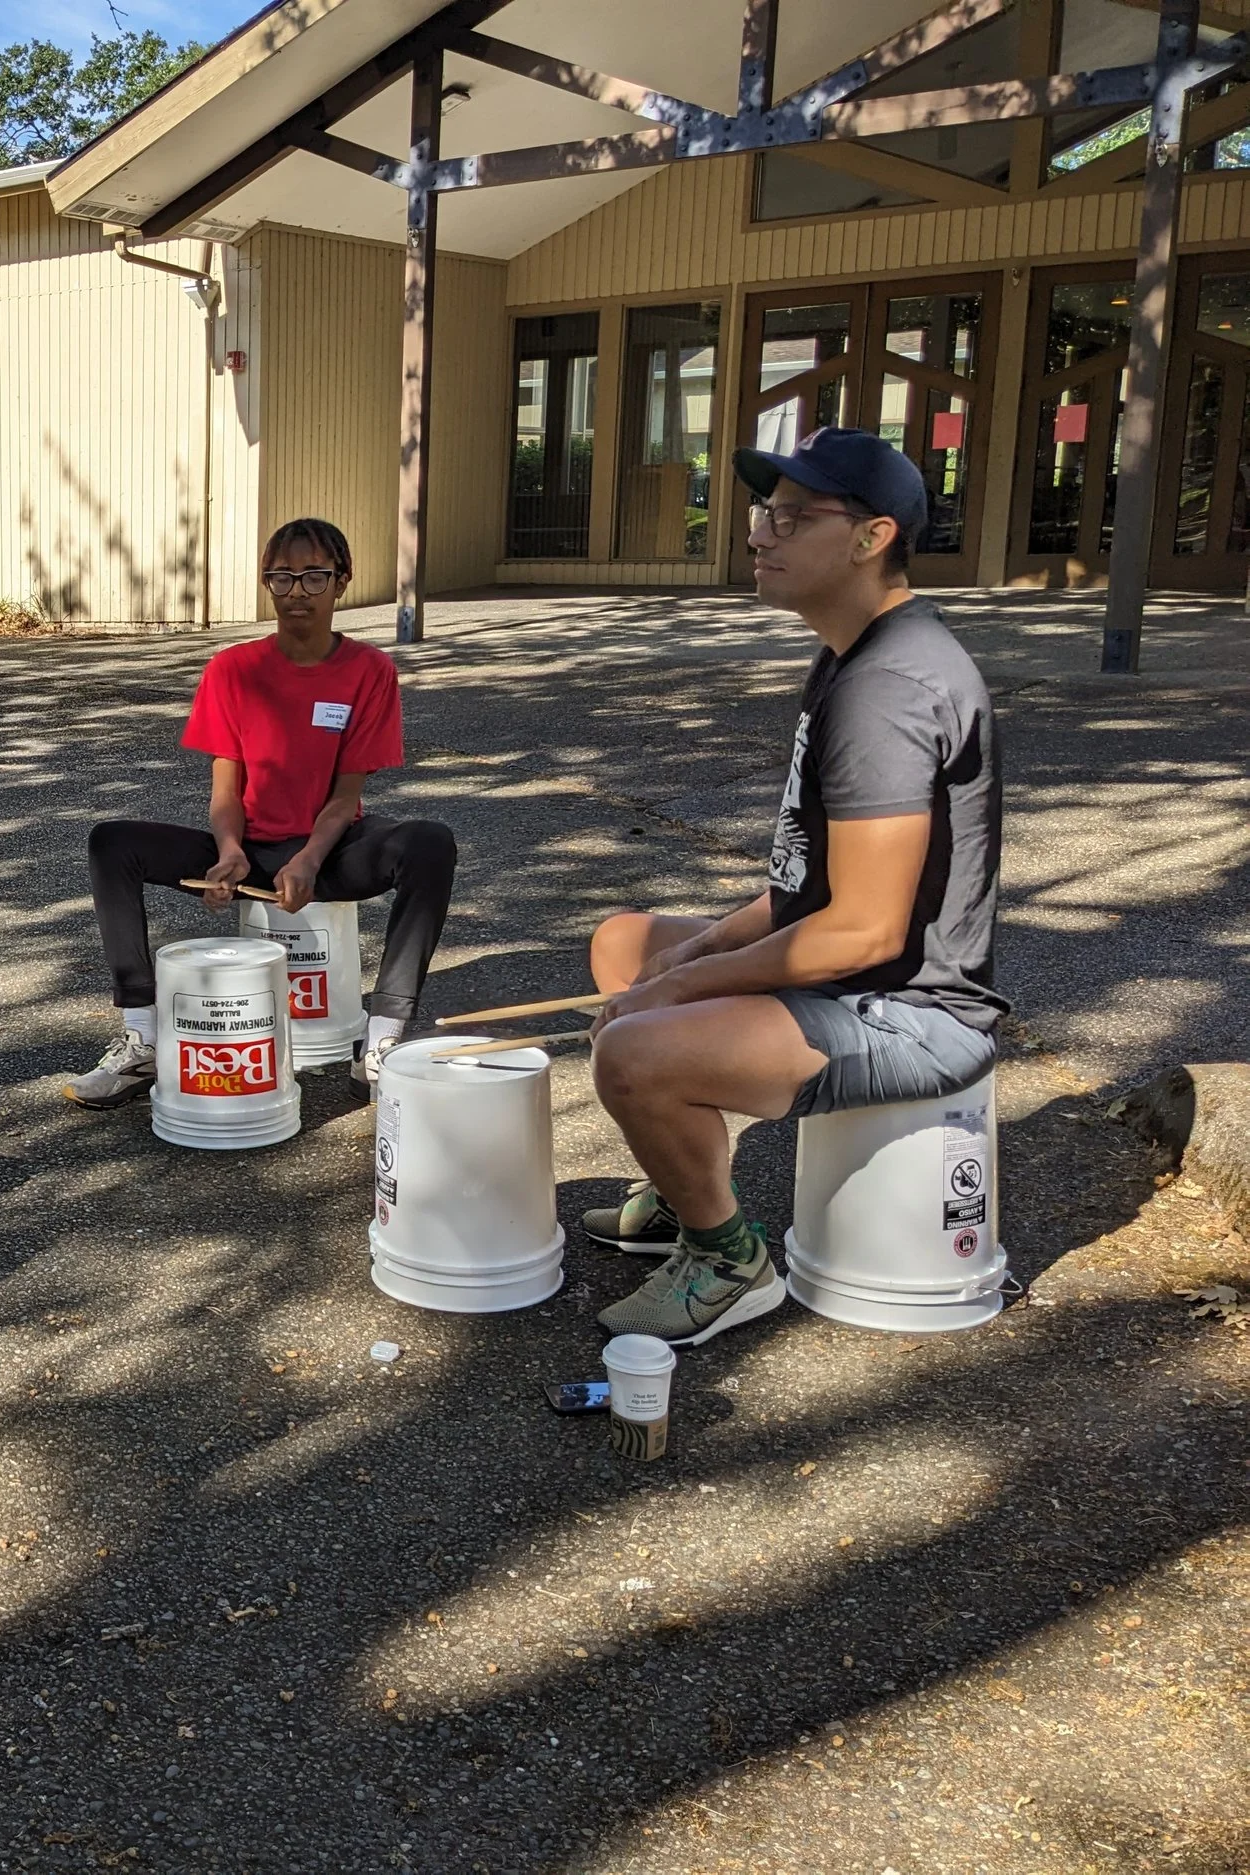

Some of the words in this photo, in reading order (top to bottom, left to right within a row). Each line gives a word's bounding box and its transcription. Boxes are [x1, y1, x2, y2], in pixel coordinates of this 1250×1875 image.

[287, 951, 326, 962] STONEWA
[202, 999, 249, 1008] 206-724-0571
[210, 1010, 241, 1018] BALLARD
[176, 1018, 226, 1031] HARDWARE
[229, 1016, 274, 1031] STONEWAY
[182, 1042, 275, 1085] Best
[958, 1206, 979, 1217] AVISO
[947, 1217, 979, 1229] WARNING
